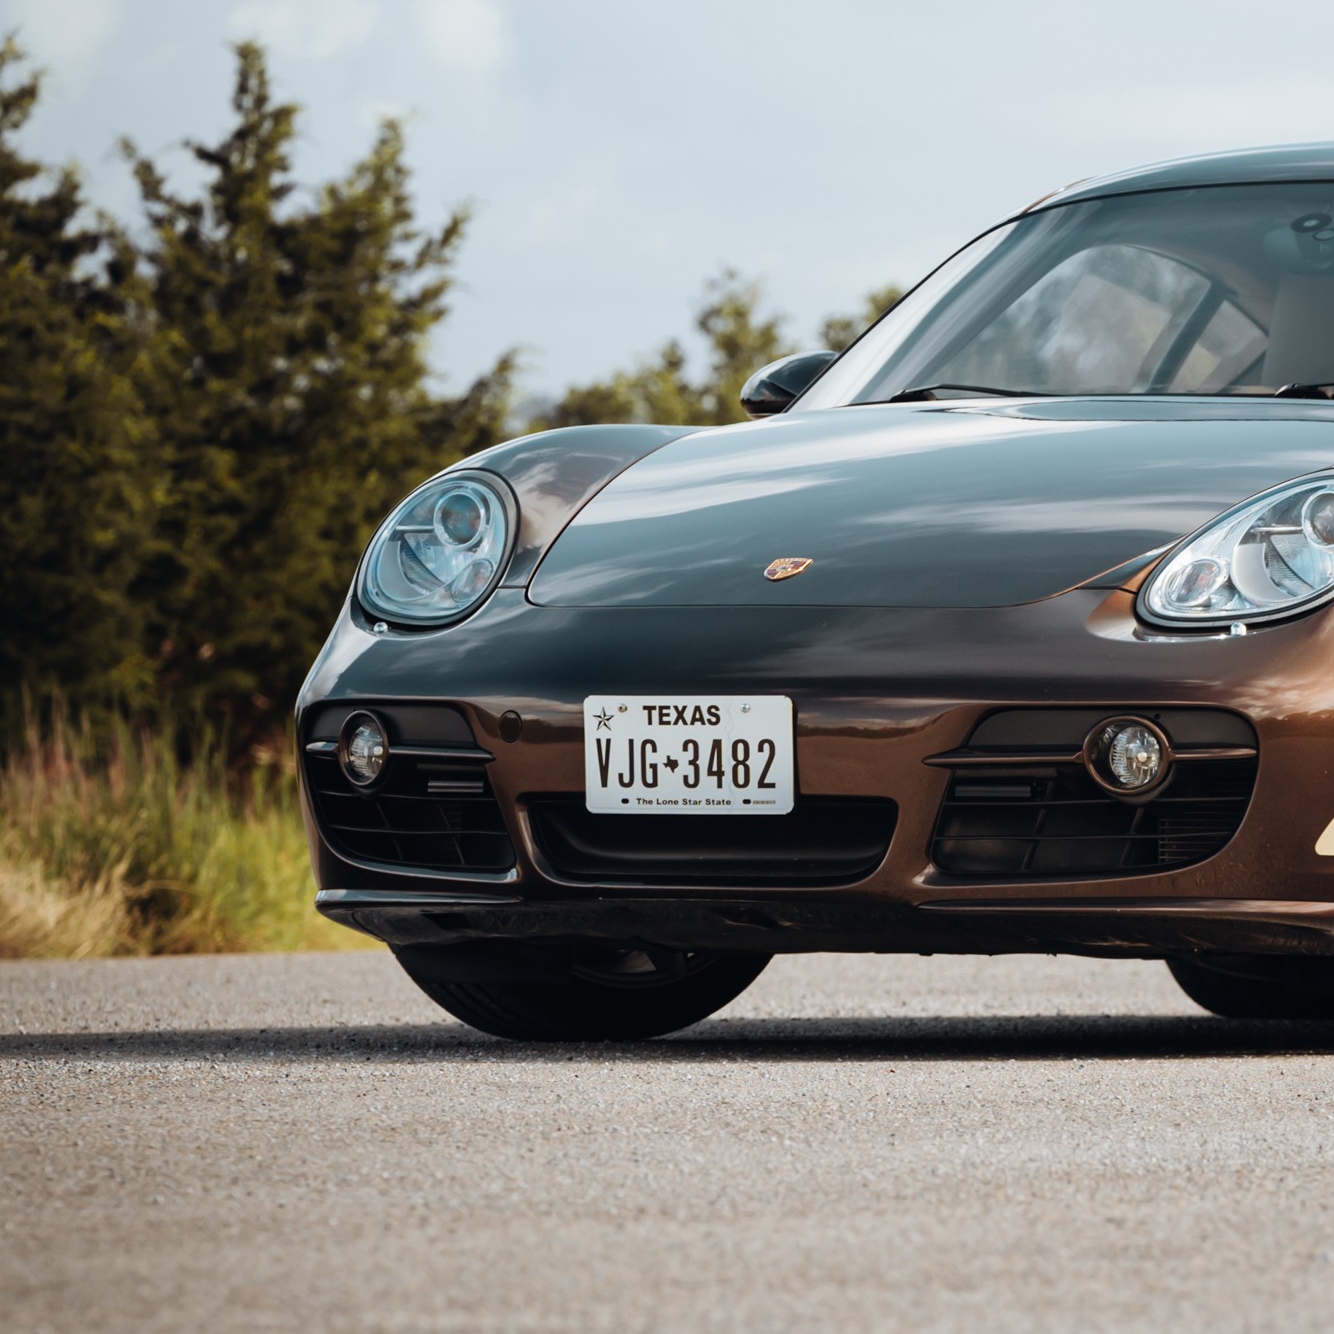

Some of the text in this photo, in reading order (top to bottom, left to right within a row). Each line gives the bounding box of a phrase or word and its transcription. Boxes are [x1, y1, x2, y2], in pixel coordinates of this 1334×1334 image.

[642, 705, 721, 726] TEXAS
[682, 798, 702, 806] Star
[705, 798, 732, 806] State
